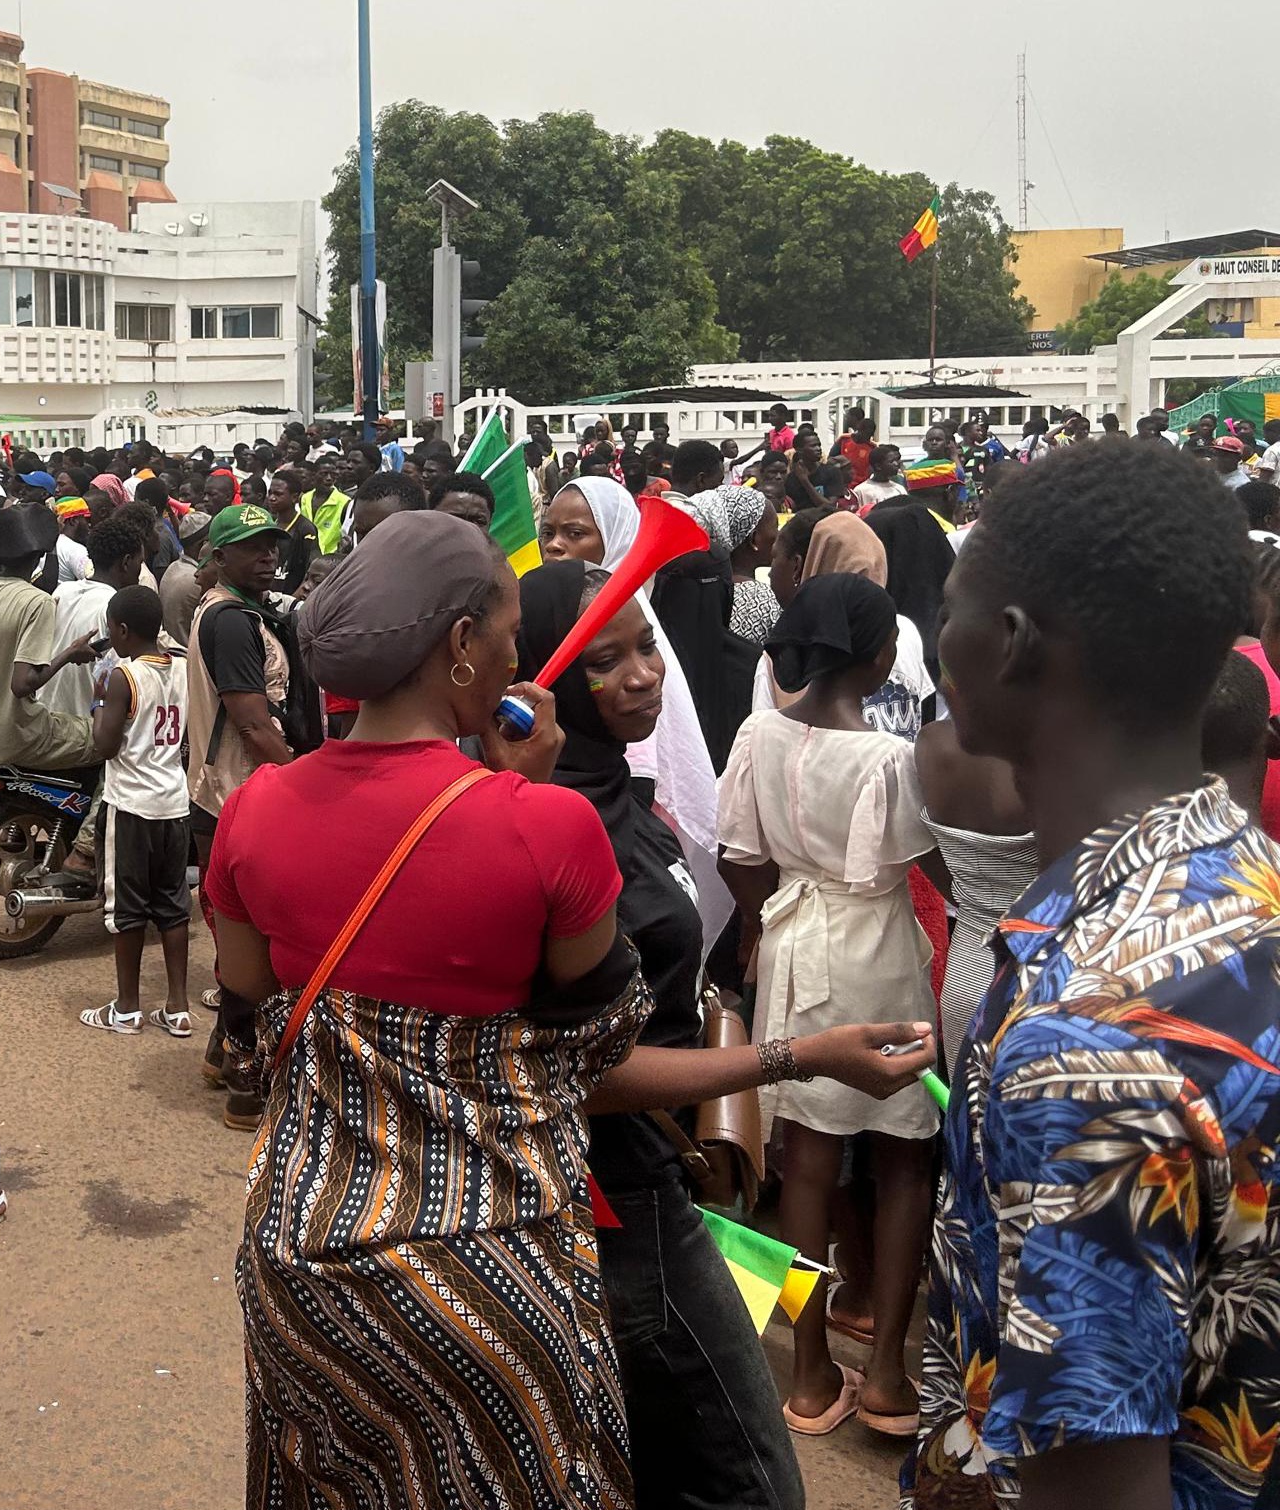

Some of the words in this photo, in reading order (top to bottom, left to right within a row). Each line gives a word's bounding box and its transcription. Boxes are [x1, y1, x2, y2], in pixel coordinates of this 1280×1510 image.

[1214, 261, 1236, 275] HAUT
[1237, 260, 1269, 274] CONSEIL
[154, 705, 180, 746] 23
